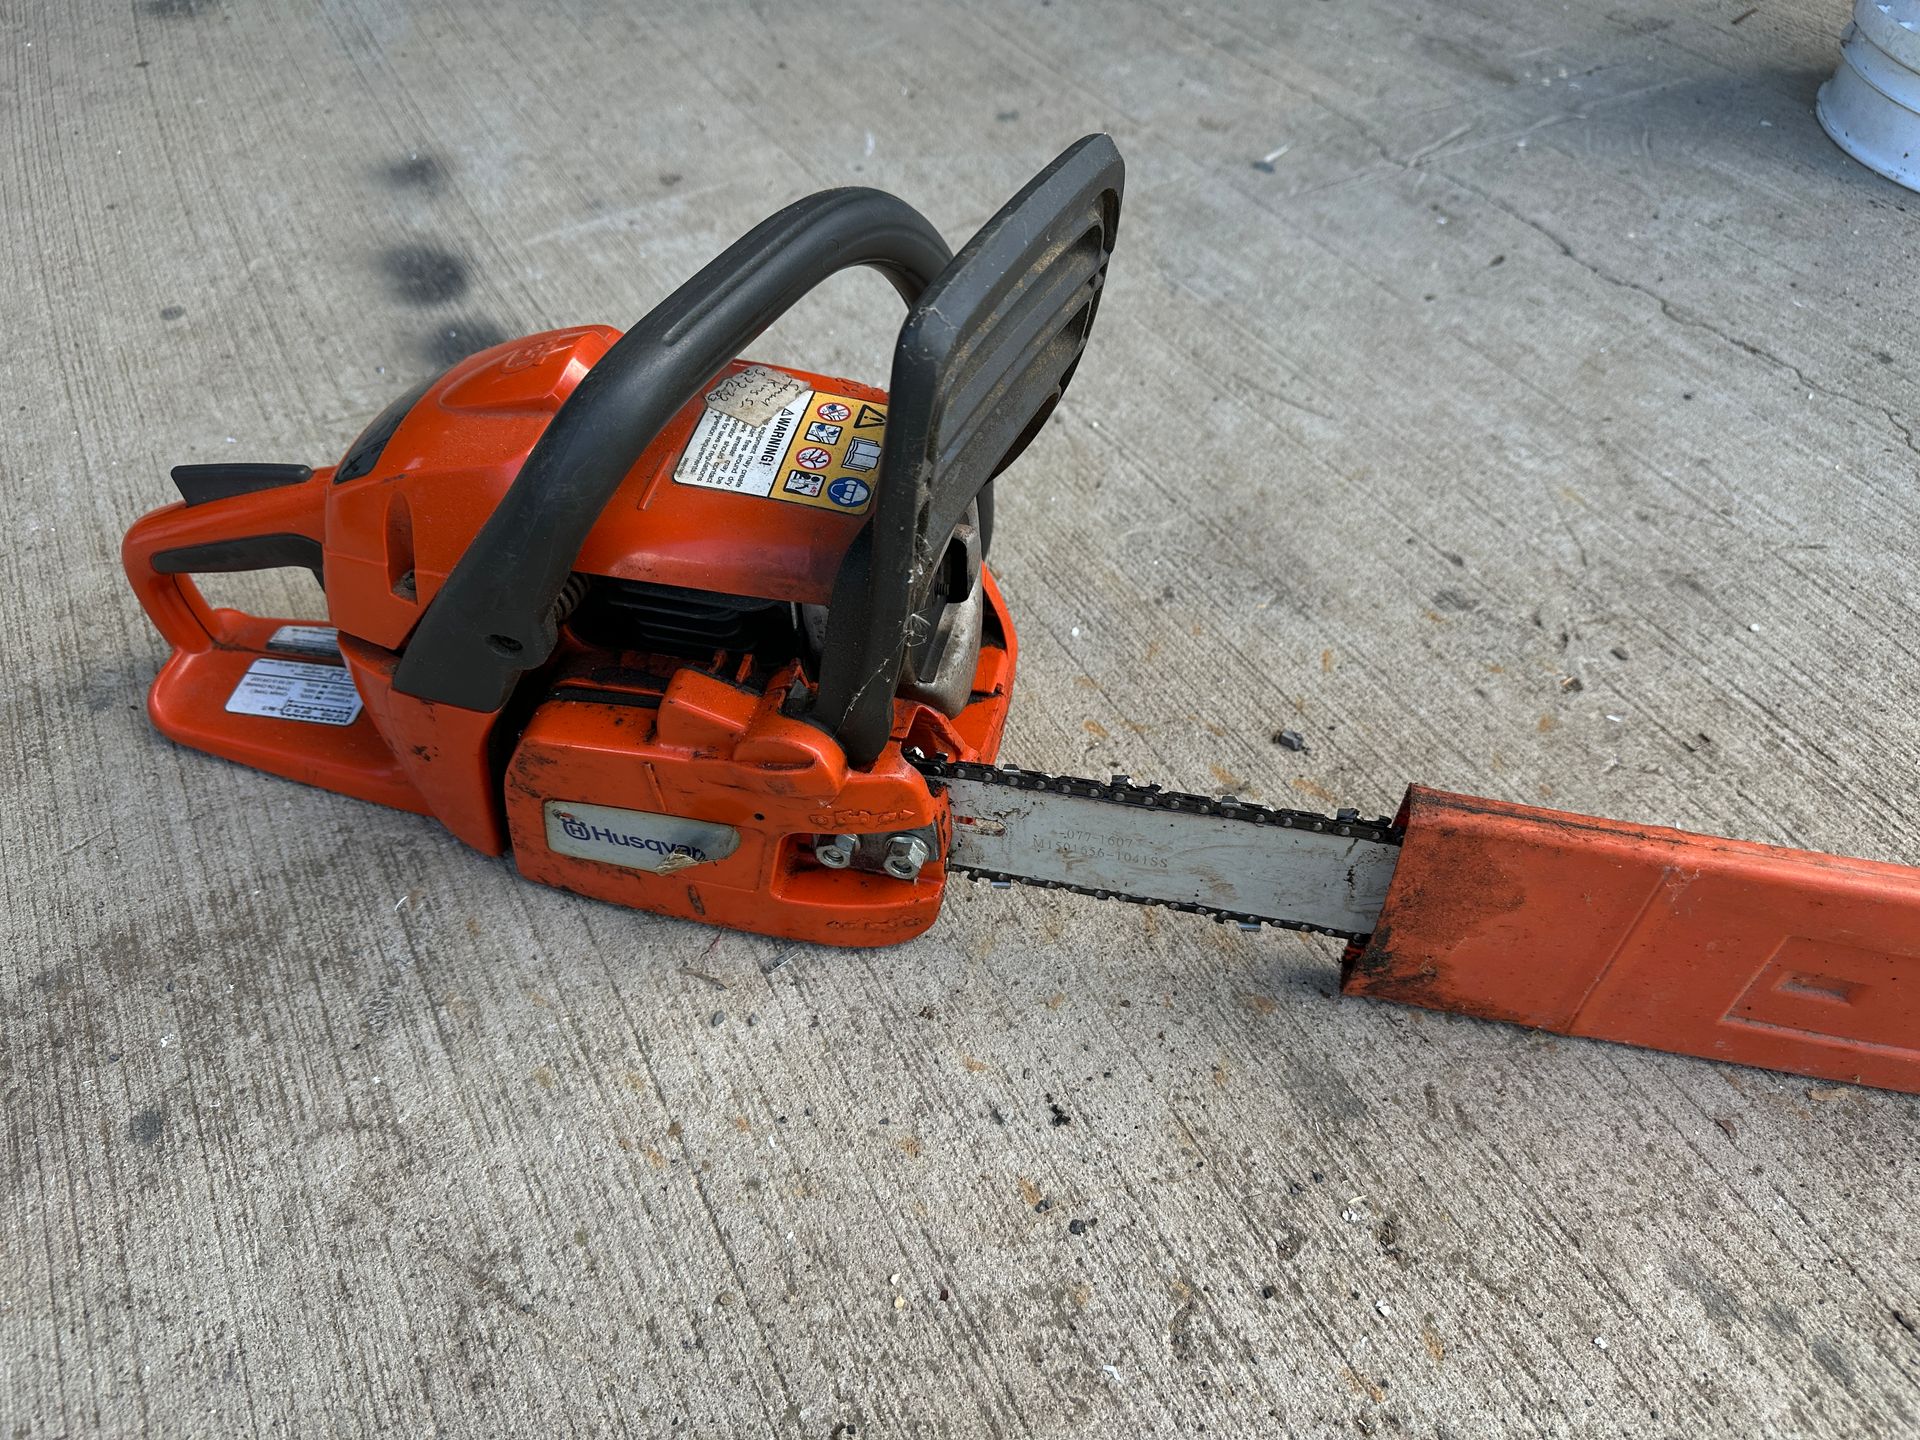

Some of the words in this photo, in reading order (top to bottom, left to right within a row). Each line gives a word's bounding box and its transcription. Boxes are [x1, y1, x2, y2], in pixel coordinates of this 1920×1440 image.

[713, 429, 726, 443] laws
[719, 422, 730, 431] for
[725, 418, 740, 439] perator
[740, 438, 752, 452] fires
[748, 425, 768, 454] equipment
[757, 416, 792, 466] WARNING!
[716, 440, 731, 460] should
[694, 449, 717, 482] regulations
[718, 459, 731, 473] may
[730, 452, 746, 474] around
[741, 454, 754, 468] may
[705, 461, 721, 483] contact
[714, 476, 724, 485] be
[722, 475, 735, 487] dry
[734, 468, 749, 488] create
